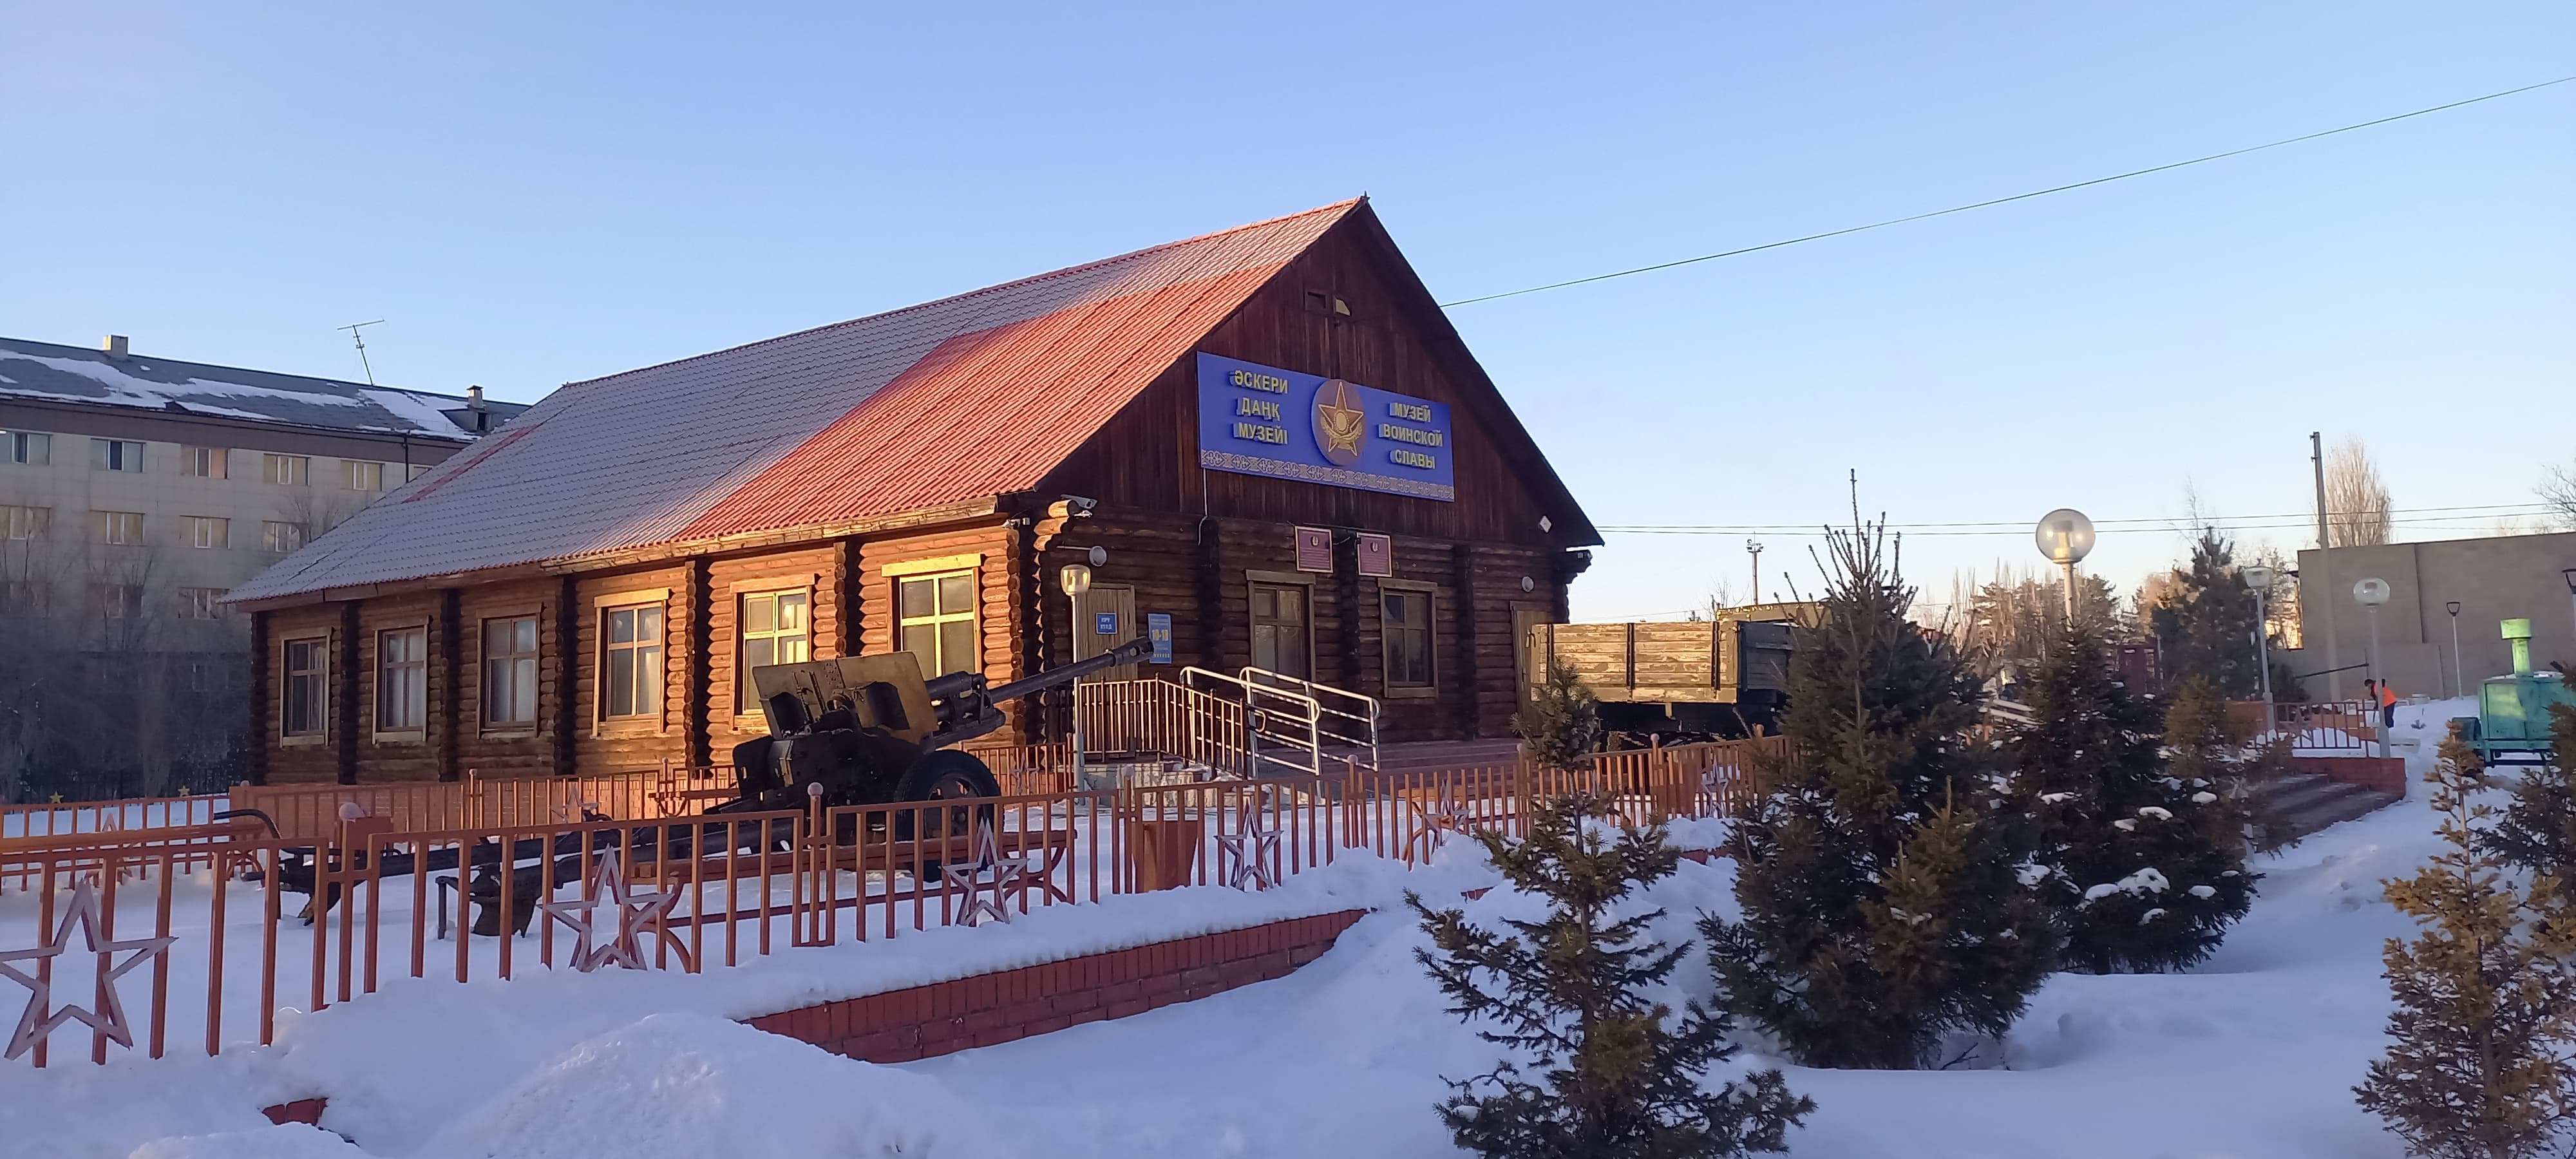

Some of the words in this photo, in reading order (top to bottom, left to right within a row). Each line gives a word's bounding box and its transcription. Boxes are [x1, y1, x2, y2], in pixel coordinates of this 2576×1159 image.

[1233, 370, 1288, 394] ӘСКЕРИ
[1240, 397, 1280, 422] ДАҢҚ
[1392, 402, 1431, 423] МУЗЕЙ
[1237, 422, 1288, 444] МУЗЕЙІ
[1382, 423, 1443, 447] ВОИНСКОЙ
[1394, 449, 1435, 469] СЛАВЫ
